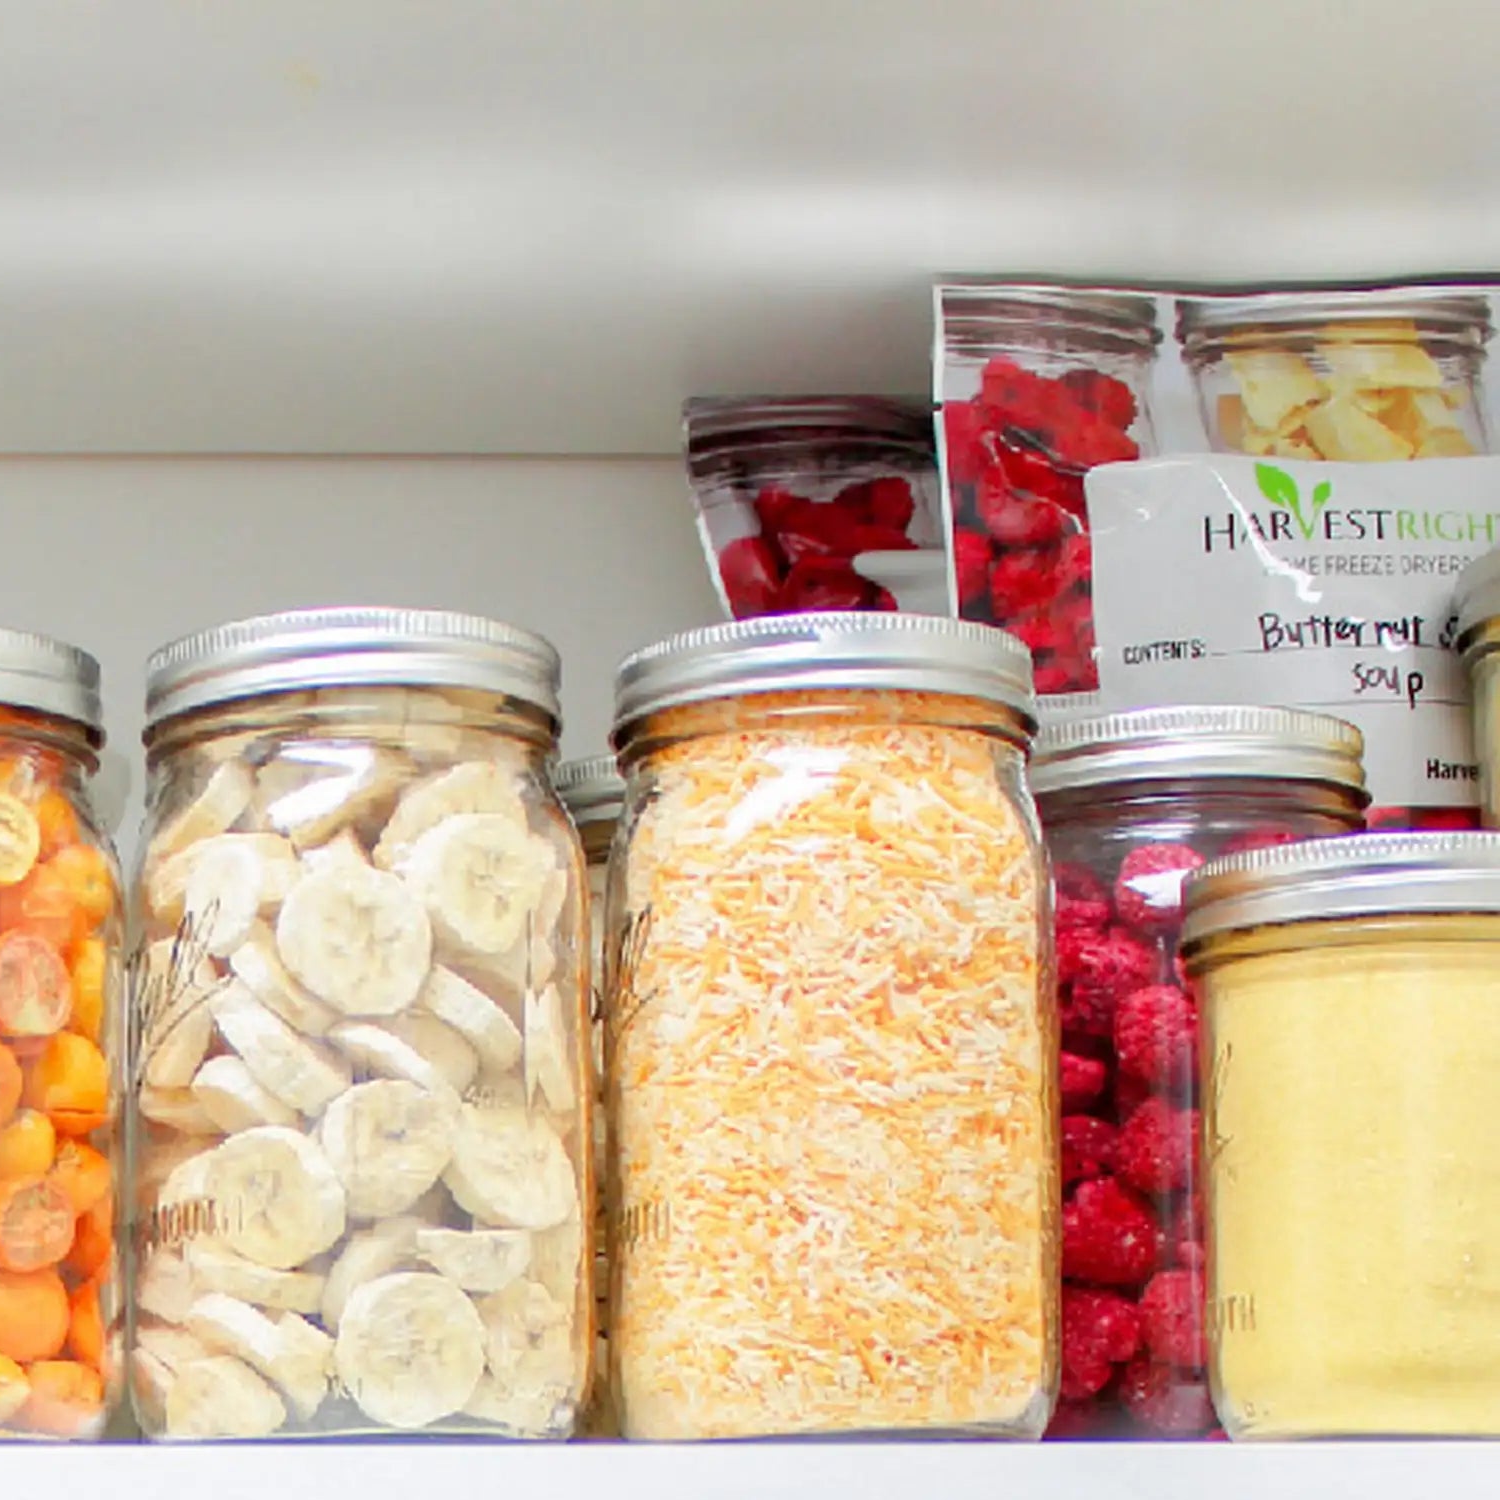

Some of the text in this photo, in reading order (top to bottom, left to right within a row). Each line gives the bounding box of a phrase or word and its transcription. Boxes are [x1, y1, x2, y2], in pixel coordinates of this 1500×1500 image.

[1204, 494, 1500, 552] HARVESTRIGH
[1324, 555, 1396, 575] FREEZE
[1123, 639, 1207, 664] CONTENTS:
